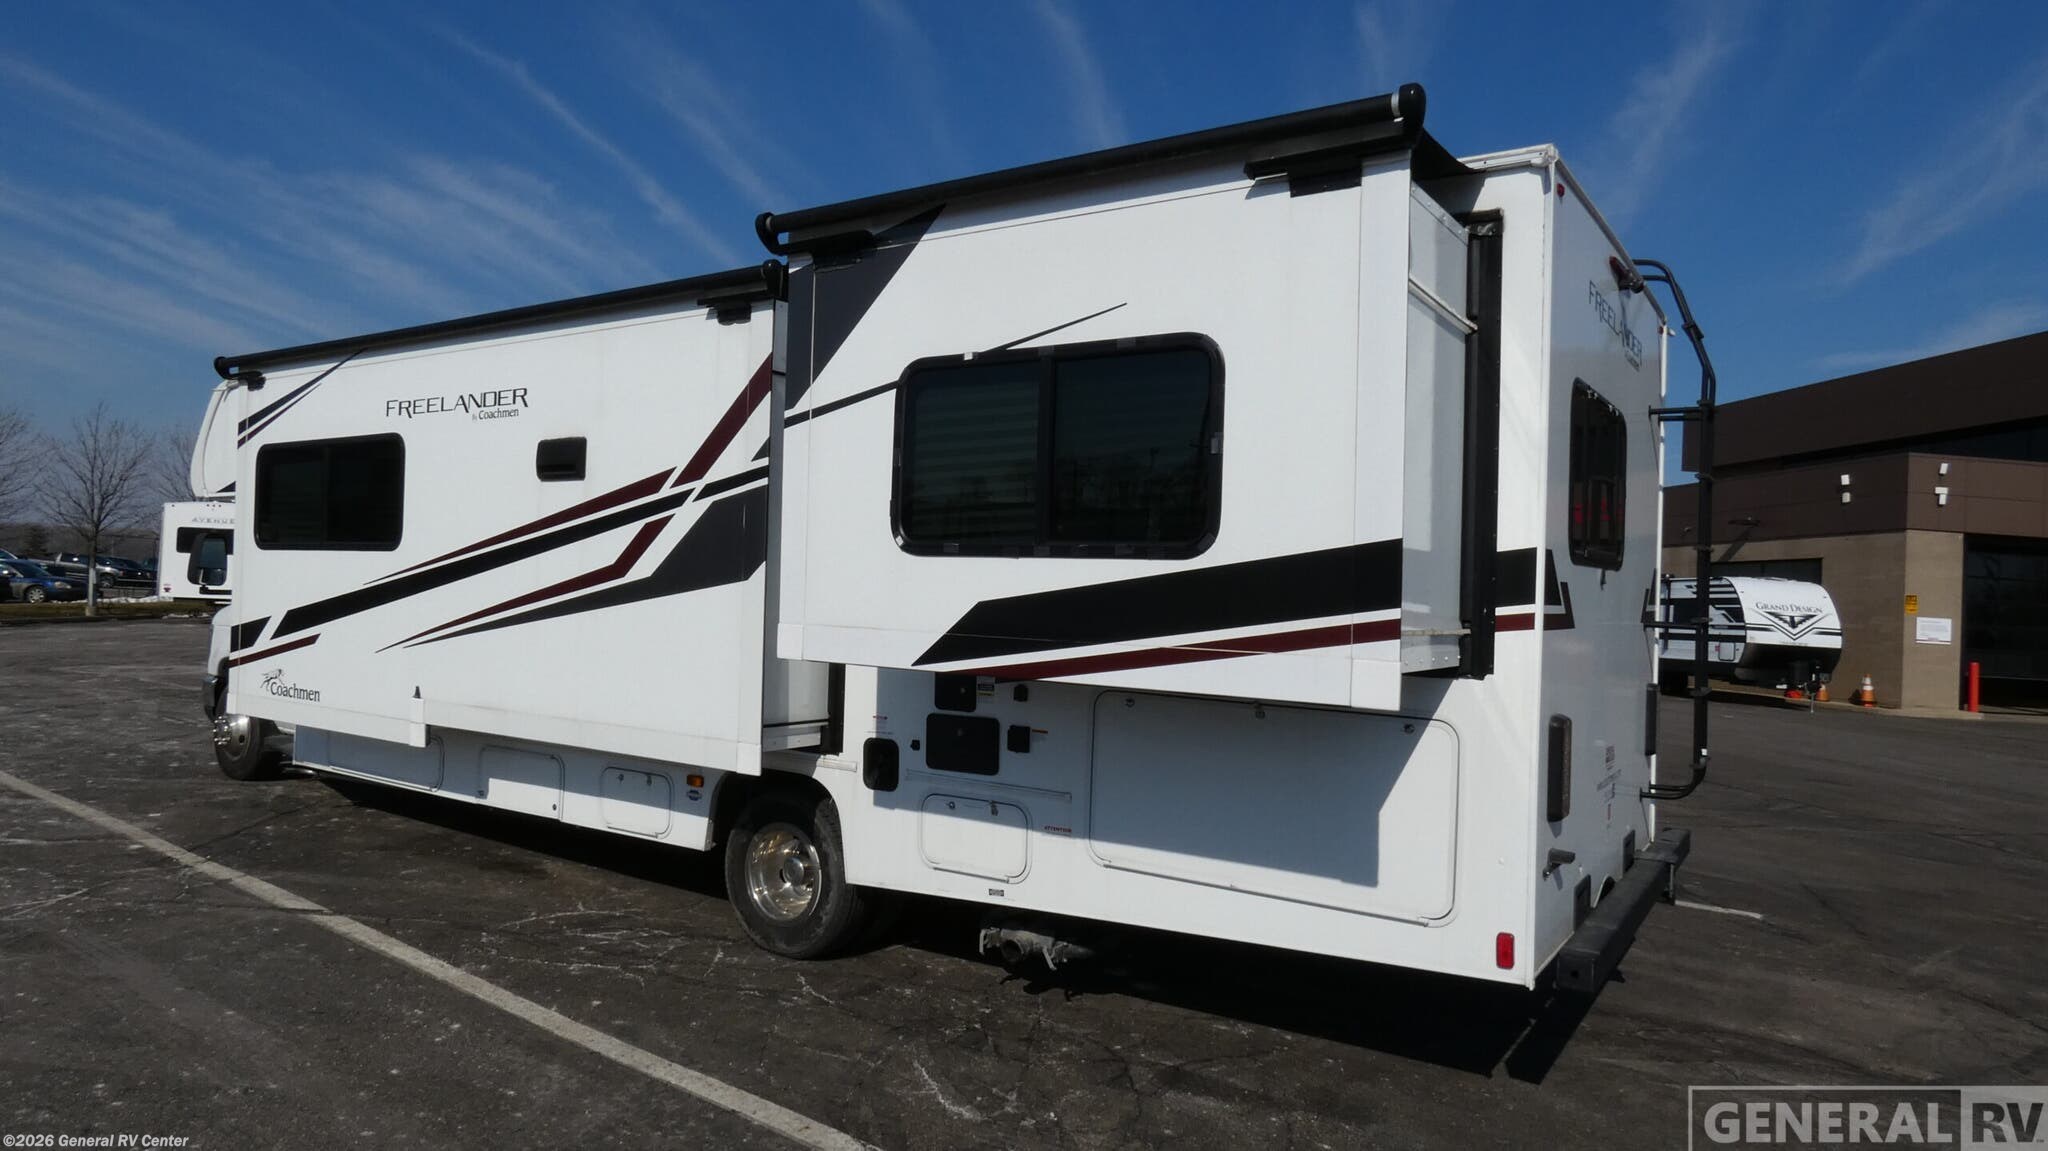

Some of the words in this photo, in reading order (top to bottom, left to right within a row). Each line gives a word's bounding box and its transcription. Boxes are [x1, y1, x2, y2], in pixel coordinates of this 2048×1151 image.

[1589, 280, 1642, 366] FREELANDER
[386, 388, 528, 418] FREELANDER
[479, 407, 519, 421] Coachmen
[1755, 601, 1788, 611] GRAND
[1789, 603, 1823, 613] DESIGN
[270, 681, 320, 702] Coachmen
